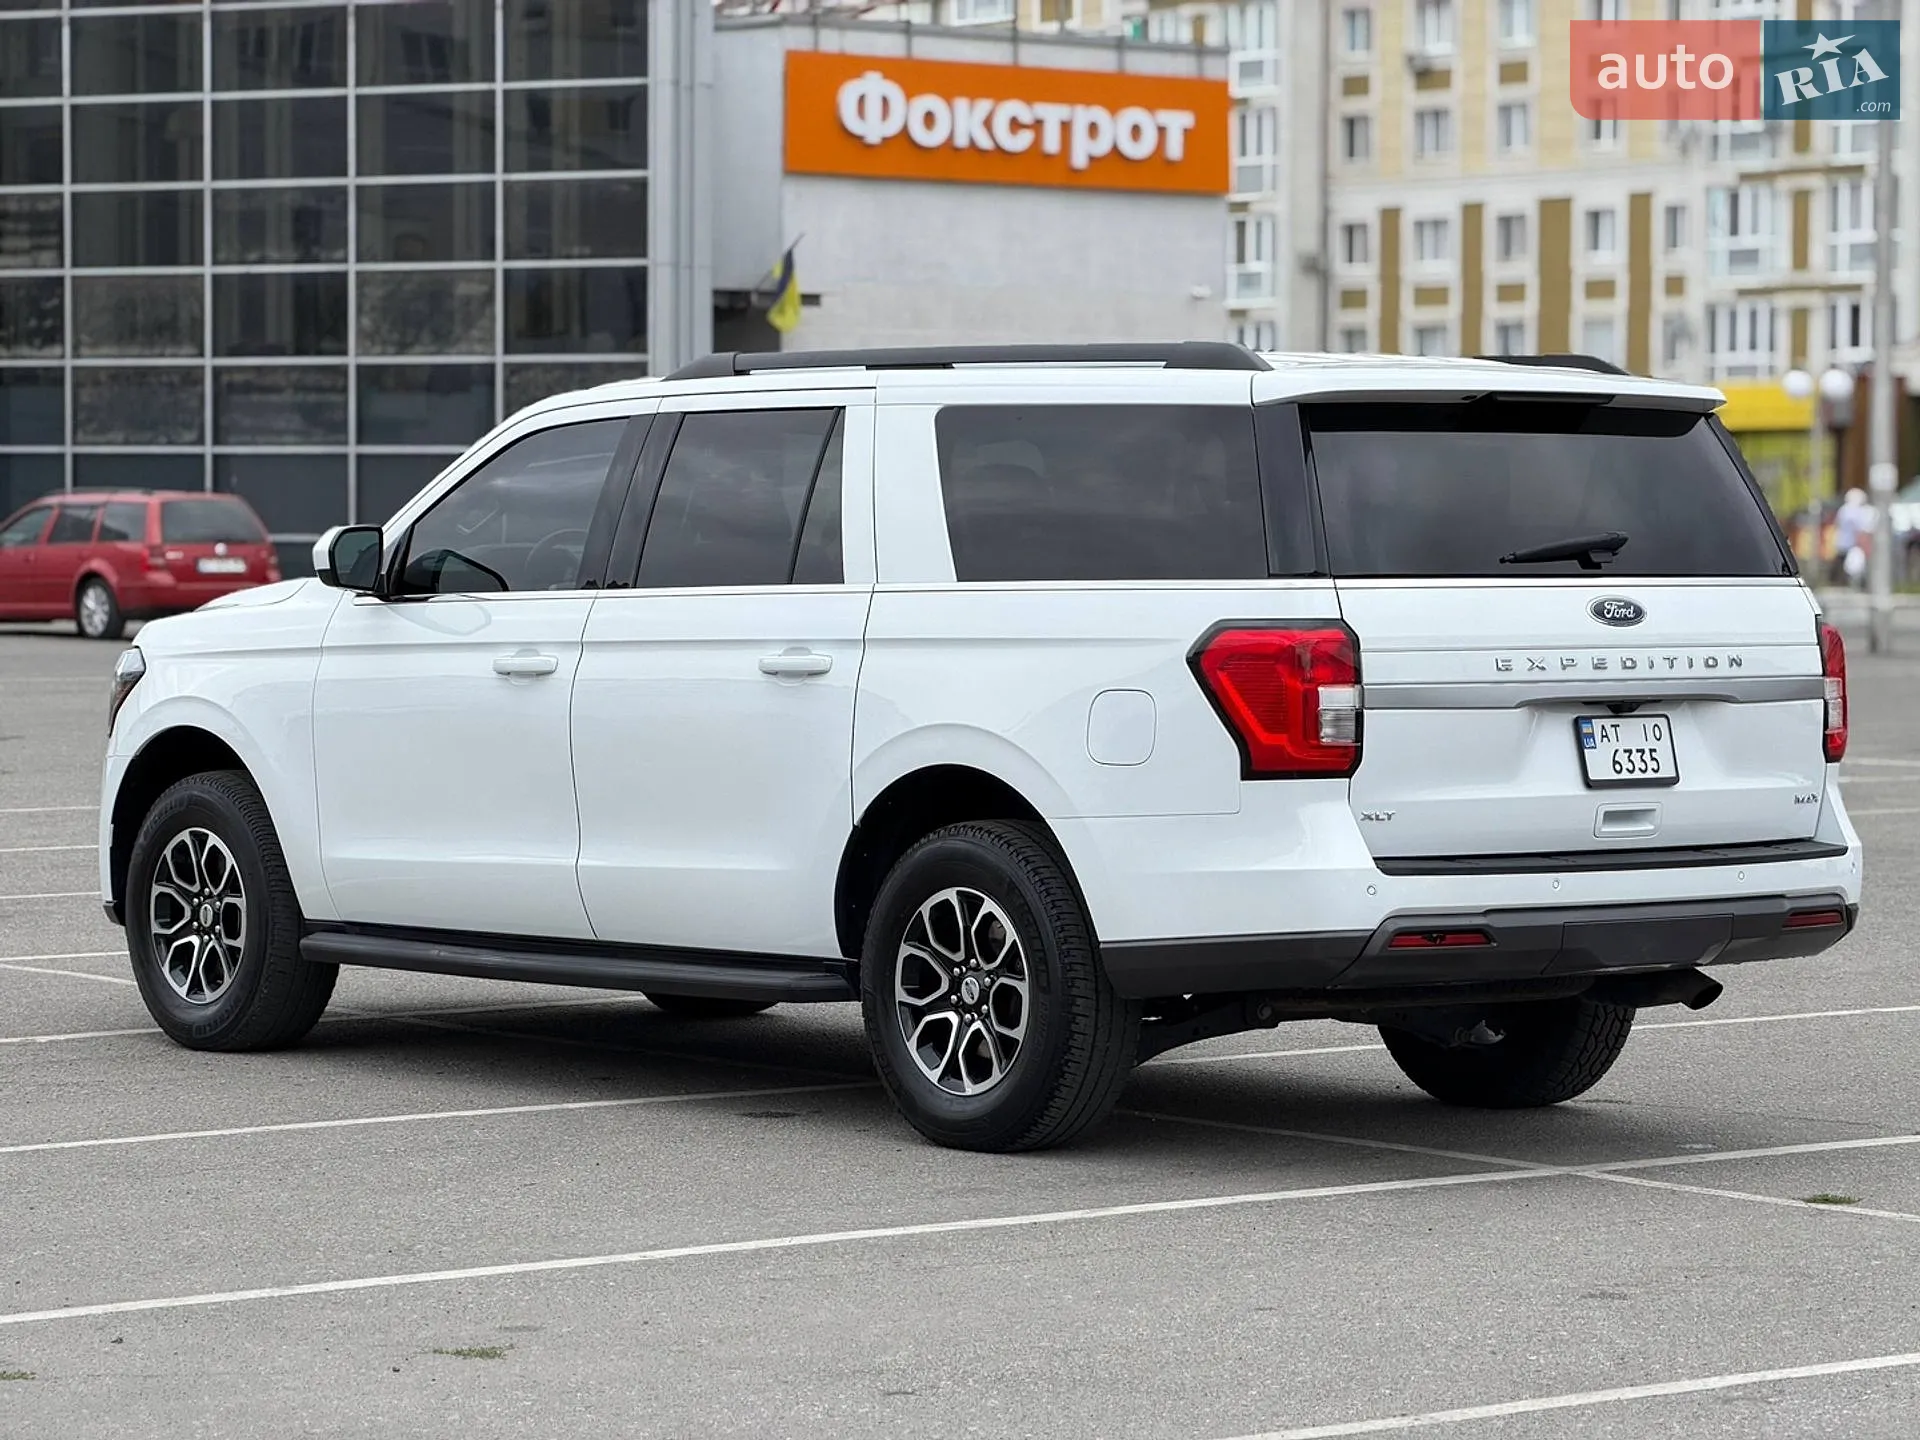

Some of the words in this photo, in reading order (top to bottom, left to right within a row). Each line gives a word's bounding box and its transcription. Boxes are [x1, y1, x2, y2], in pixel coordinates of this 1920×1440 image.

[837, 70, 1195, 170] Фокстрот
[1603, 600, 1636, 619] Ford
[1494, 655, 1743, 672] EXPEDITION
[1599, 723, 1620, 742] AT
[1612, 748, 1660, 774] 6335
[1360, 811, 1396, 821] XLT
